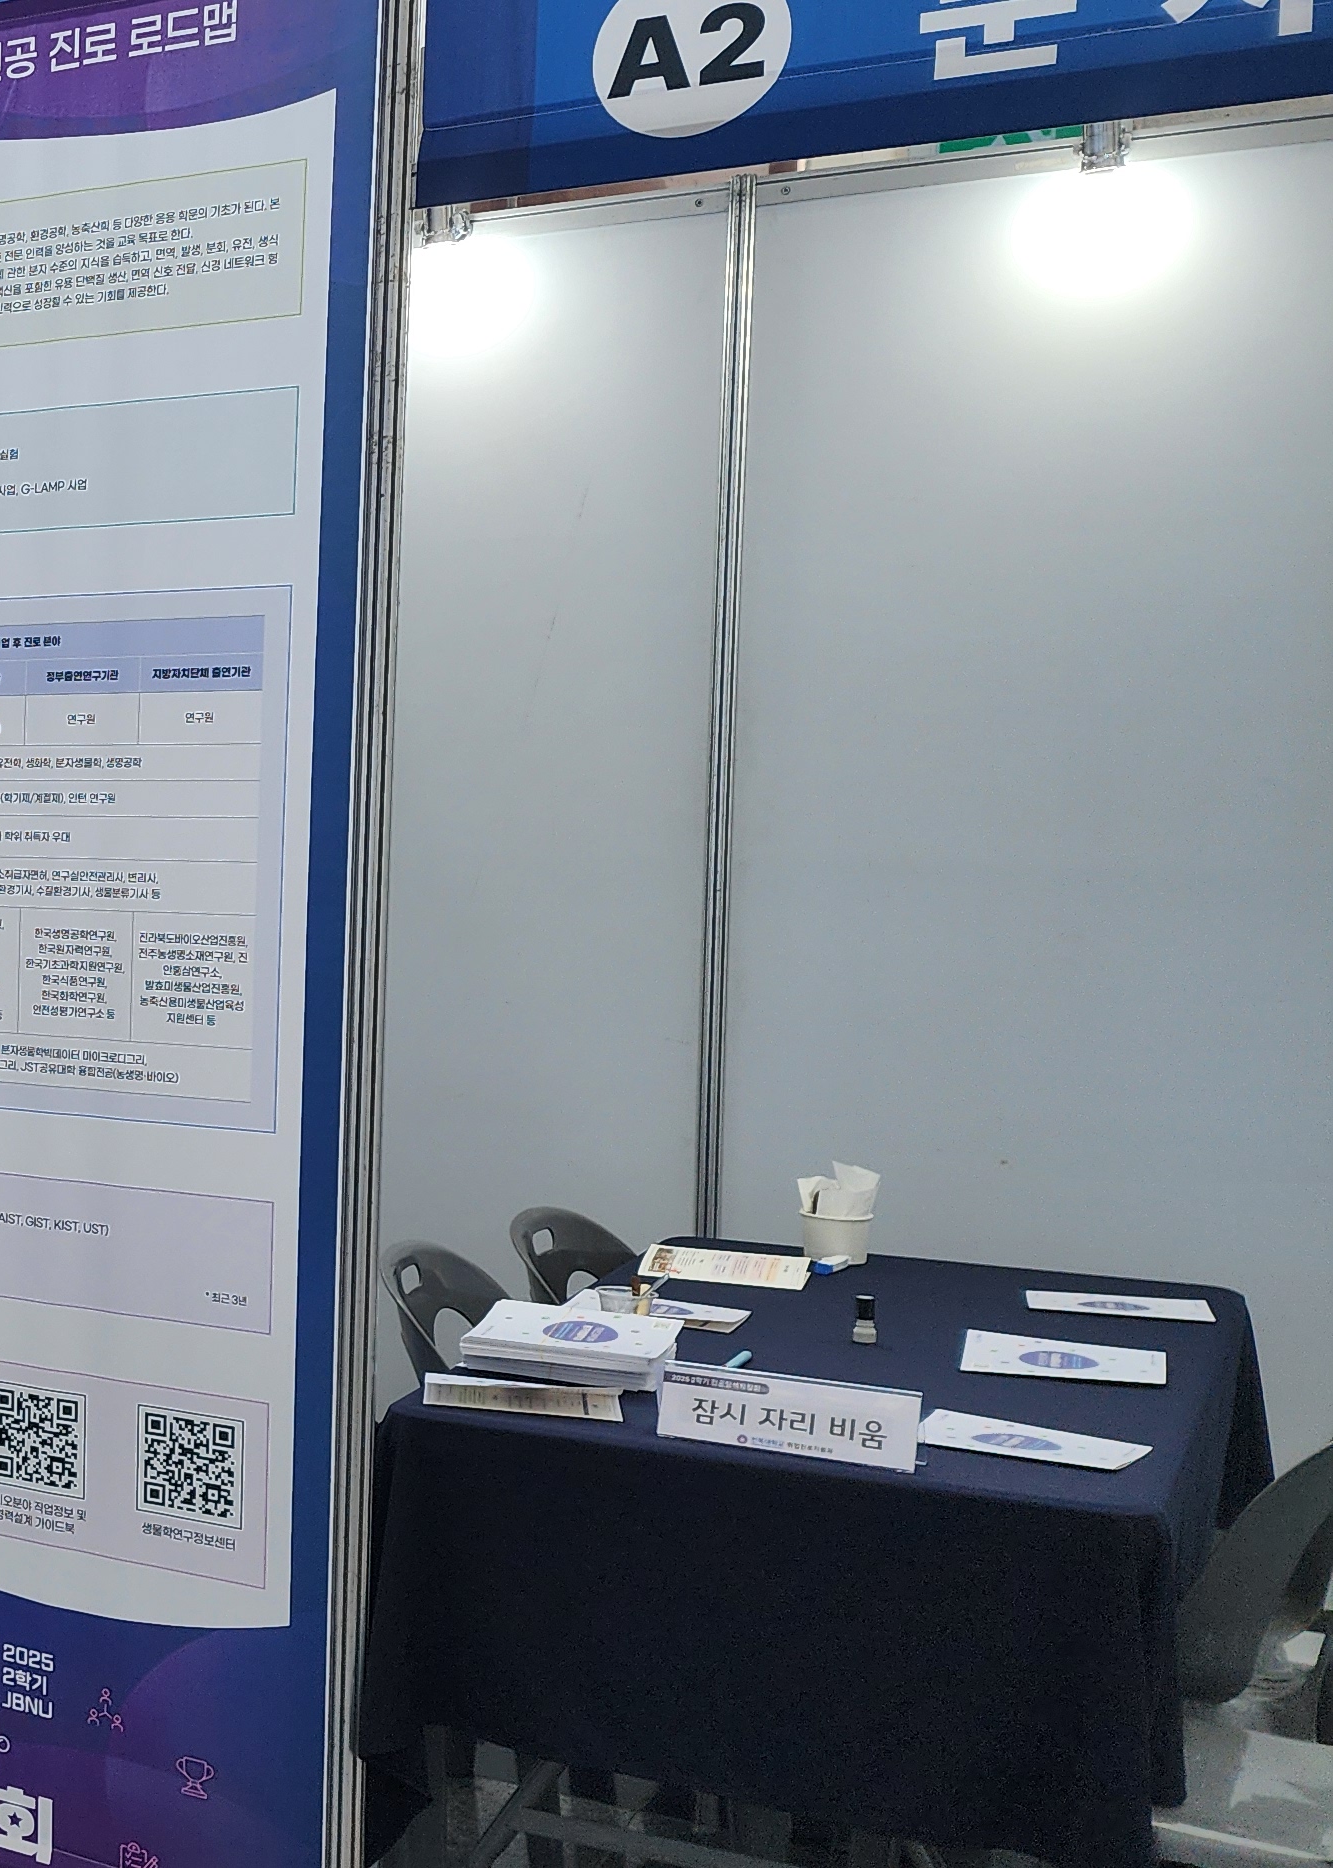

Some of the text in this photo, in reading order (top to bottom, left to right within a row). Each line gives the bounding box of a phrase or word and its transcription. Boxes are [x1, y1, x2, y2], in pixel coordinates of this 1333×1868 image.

[48, 23, 116, 72] 진로
[129, 1, 237, 58] 로드맵
[607, 3, 766, 99] A2
[210, 202, 241, 216] 기초가
[243, 199, 267, 213] 된다.
[170, 227, 193, 240] 한다.
[20, 480, 65, 494] G-LAMP
[66, 478, 87, 490] 사업
[67, 713, 95, 724] 연구원
[185, 711, 213, 723] 연구원
[24, 1215, 51, 1230] GIST,
[53, 1219, 81, 1232] KIST,
[83, 1222, 109, 1236] UST)
[211, 1292, 247, 1306] 최근 3년
[692, 1397, 888, 1450] 잠시 자리 비움
[34, 1501, 74, 1518] 직업정보
[76, 1509, 86, 1521] 및
[34, 1516, 74, 1533] 가이드북
[141, 1523, 235, 1549] 생물학연구정보센터
[2, 1643, 54, 1672] 2025
[2, 1667, 48, 1694] 2학기
[1, 1690, 53, 1720] JBNU
